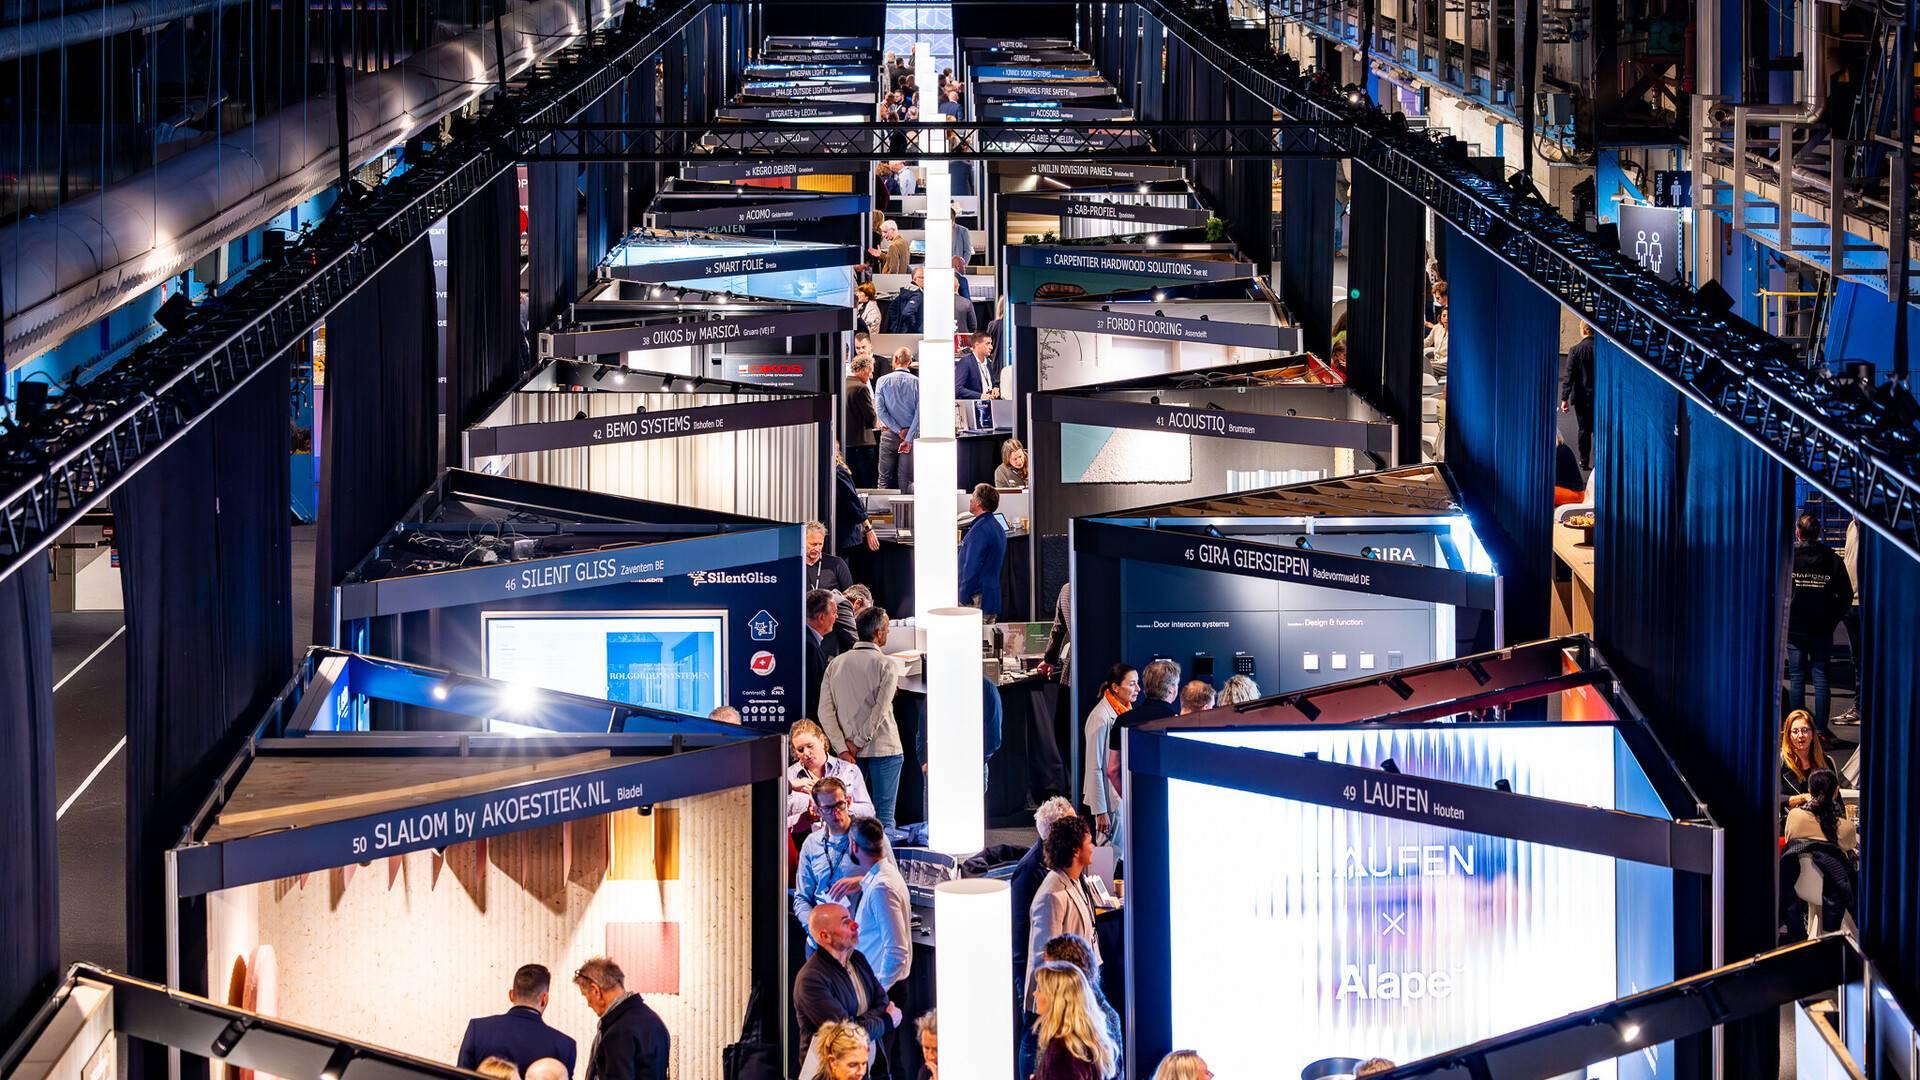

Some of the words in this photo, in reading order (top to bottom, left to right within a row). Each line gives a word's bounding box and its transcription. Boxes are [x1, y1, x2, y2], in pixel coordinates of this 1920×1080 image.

[790, 69, 811, 77] KINGSPAN
[793, 87, 812, 96] OUTSIDE
[812, 86, 832, 95] LIGHTING
[1012, 87, 1041, 95] HOEFNAGELS
[1052, 88, 1069, 96] SAFETY
[794, 109, 801, 118] by
[1036, 109, 1060, 118] ACOSORB
[752, 166, 772, 176] KEGRO
[773, 164, 797, 175] DEUREN
[1038, 164, 1059, 174] UNILIN
[1060, 165, 1089, 175] DIVISION
[1089, 166, 1113, 176] PANELS
[745, 208, 771, 220] ACOMO
[1074, 204, 1117, 217] SAB-PROFIEL
[705, 266, 711, 275] 34
[713, 260, 741, 274] SMART
[741, 258, 764, 271] FOLIE
[1045, 257, 1052, 265] 33
[1053, 253, 1099, 269] CARPENTIER
[1100, 257, 1146, 272] HARDWOOD
[1147, 261, 1192, 276] SOLUTIONS
[1097, 320, 1104, 329] 37
[1106, 316, 1136, 332] FORBO
[1138, 319, 1182, 336] FLOORING
[642, 336, 650, 346] 38
[652, 329, 683, 345] OIKOS
[685, 328, 697, 343] by
[699, 324, 741, 340] MARSICA
[743, 328, 758, 336] Gruaro
[759, 326, 770, 337] (VE)
[770, 326, 775, 334] IT
[592, 429, 602, 440] 42
[606, 419, 638, 438] BEMO
[640, 415, 691, 435] SYSTEMS
[715, 418, 724, 428] DE
[1156, 416, 1165, 426] 41
[1168, 411, 1225, 435] ACOUSTIQ
[1228, 423, 1256, 434] Brummen
[1184, 548, 1195, 561] 45
[1198, 543, 1231, 566] GIRA
[1233, 548, 1310, 577] GIERSIEPEN
[1312, 567, 1360, 584] Radevormwald
[1360, 575, 1371, 585] DE
[504, 578, 517, 591] 46
[521, 564, 572, 589] SILENT
[575, 558, 616, 581] GLISS
[620, 562, 654, 576] Zaventem
[655, 559, 664, 571] BE
[707, 572, 777, 584] SilentGliss
[1153, 620, 1170, 629] Door
[1171, 620, 1201, 629] intercom
[1202, 620, 1230, 630] systems
[1304, 618, 1328, 628] Design
[1328, 618, 1335, 627] &
[1335, 617, 1364, 627] function
[1343, 785, 1357, 801] 49
[1363, 779, 1429, 814] LAUFEN
[1433, 802, 1465, 820] Houten
[352, 836, 368, 854] 50
[373, 810, 449, 850] SLALOM
[454, 807, 476, 838] by
[481, 780, 611, 829] AKOESTIEK.NL
[616, 783, 644, 801] Bladel
[1335, 963, 1453, 1010] Alape
